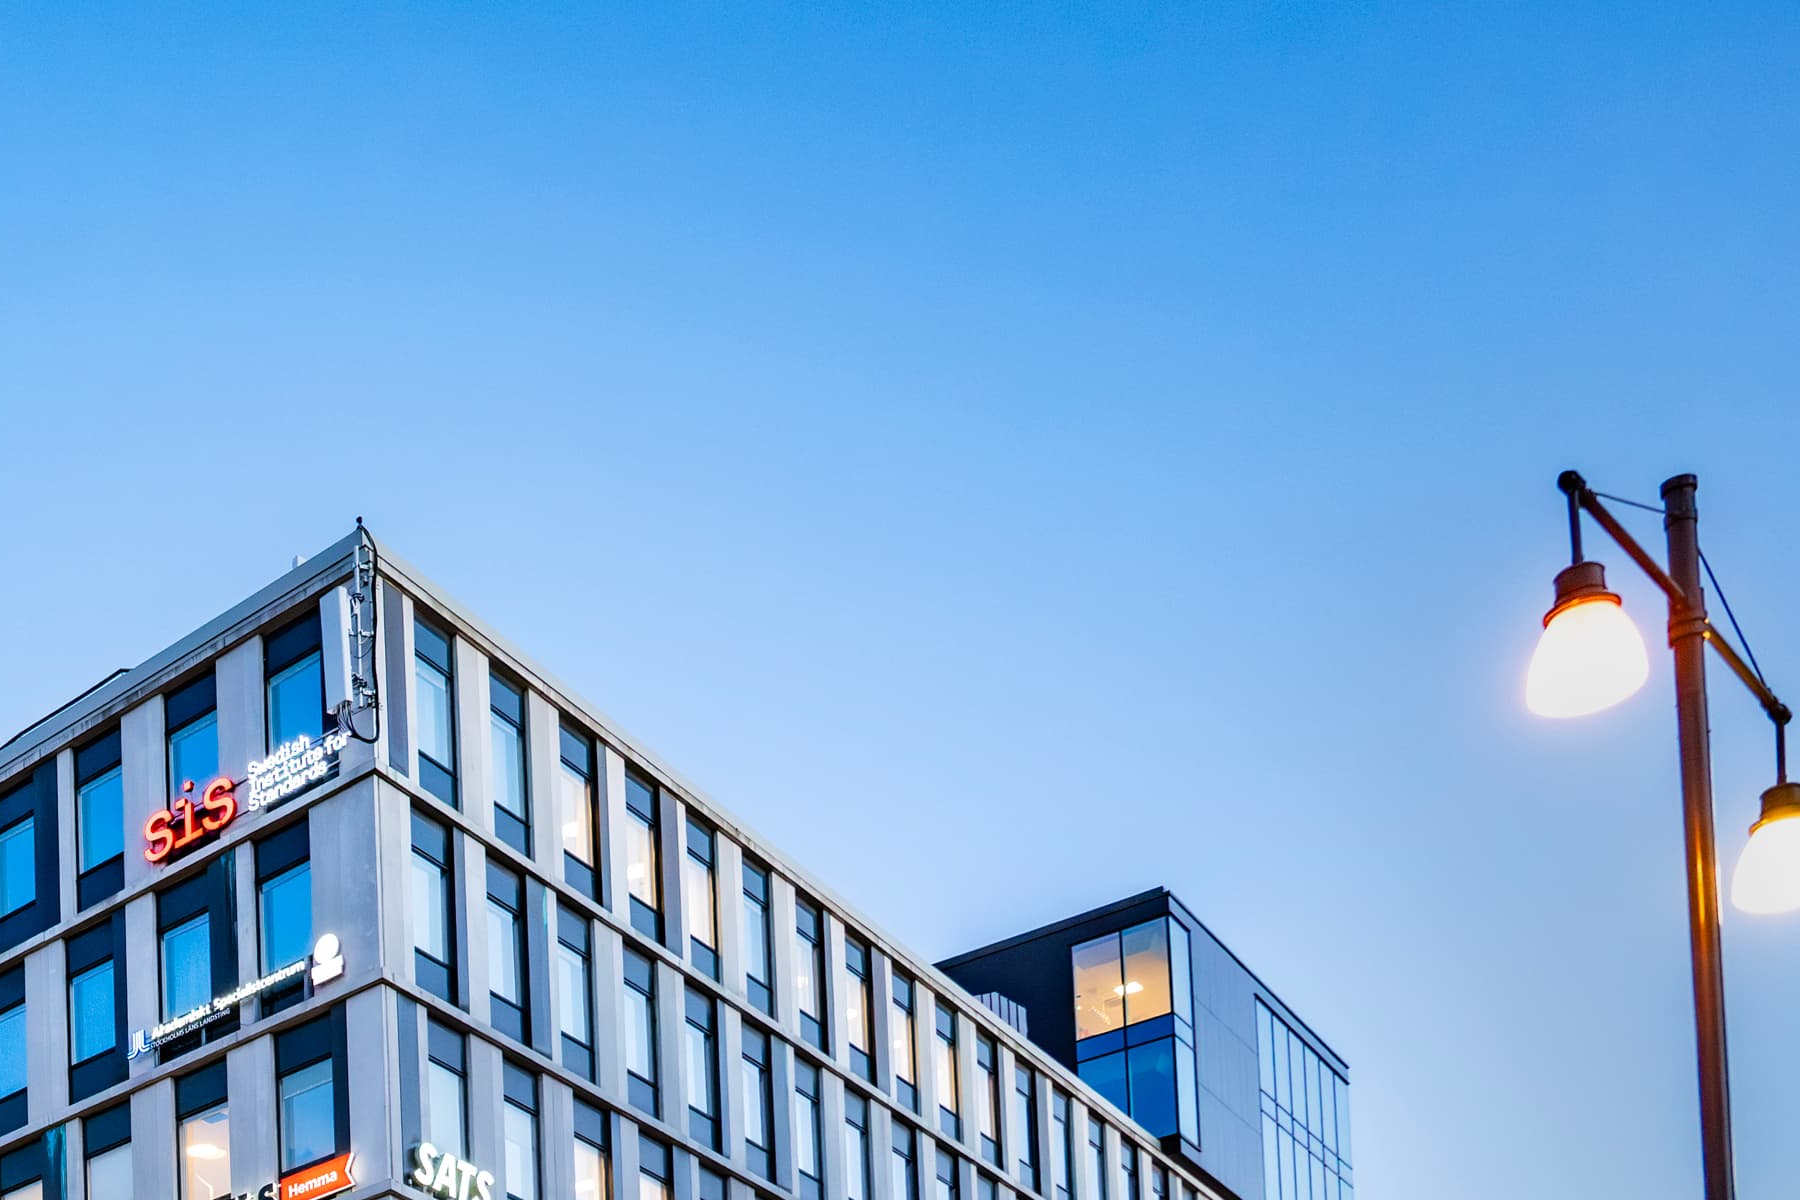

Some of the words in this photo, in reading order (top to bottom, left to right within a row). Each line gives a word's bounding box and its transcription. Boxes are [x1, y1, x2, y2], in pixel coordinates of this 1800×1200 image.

[248, 735, 310, 775] Swedish
[248, 746, 323, 793] Institute
[324, 731, 352, 755] for
[248, 761, 328, 812] Standards
[144, 777, 236, 862] sis
[150, 1029, 185, 1050] STOCKHOLMS
[199, 1007, 231, 1029] LANDSTING
[288, 1169, 338, 1199] Hemma
